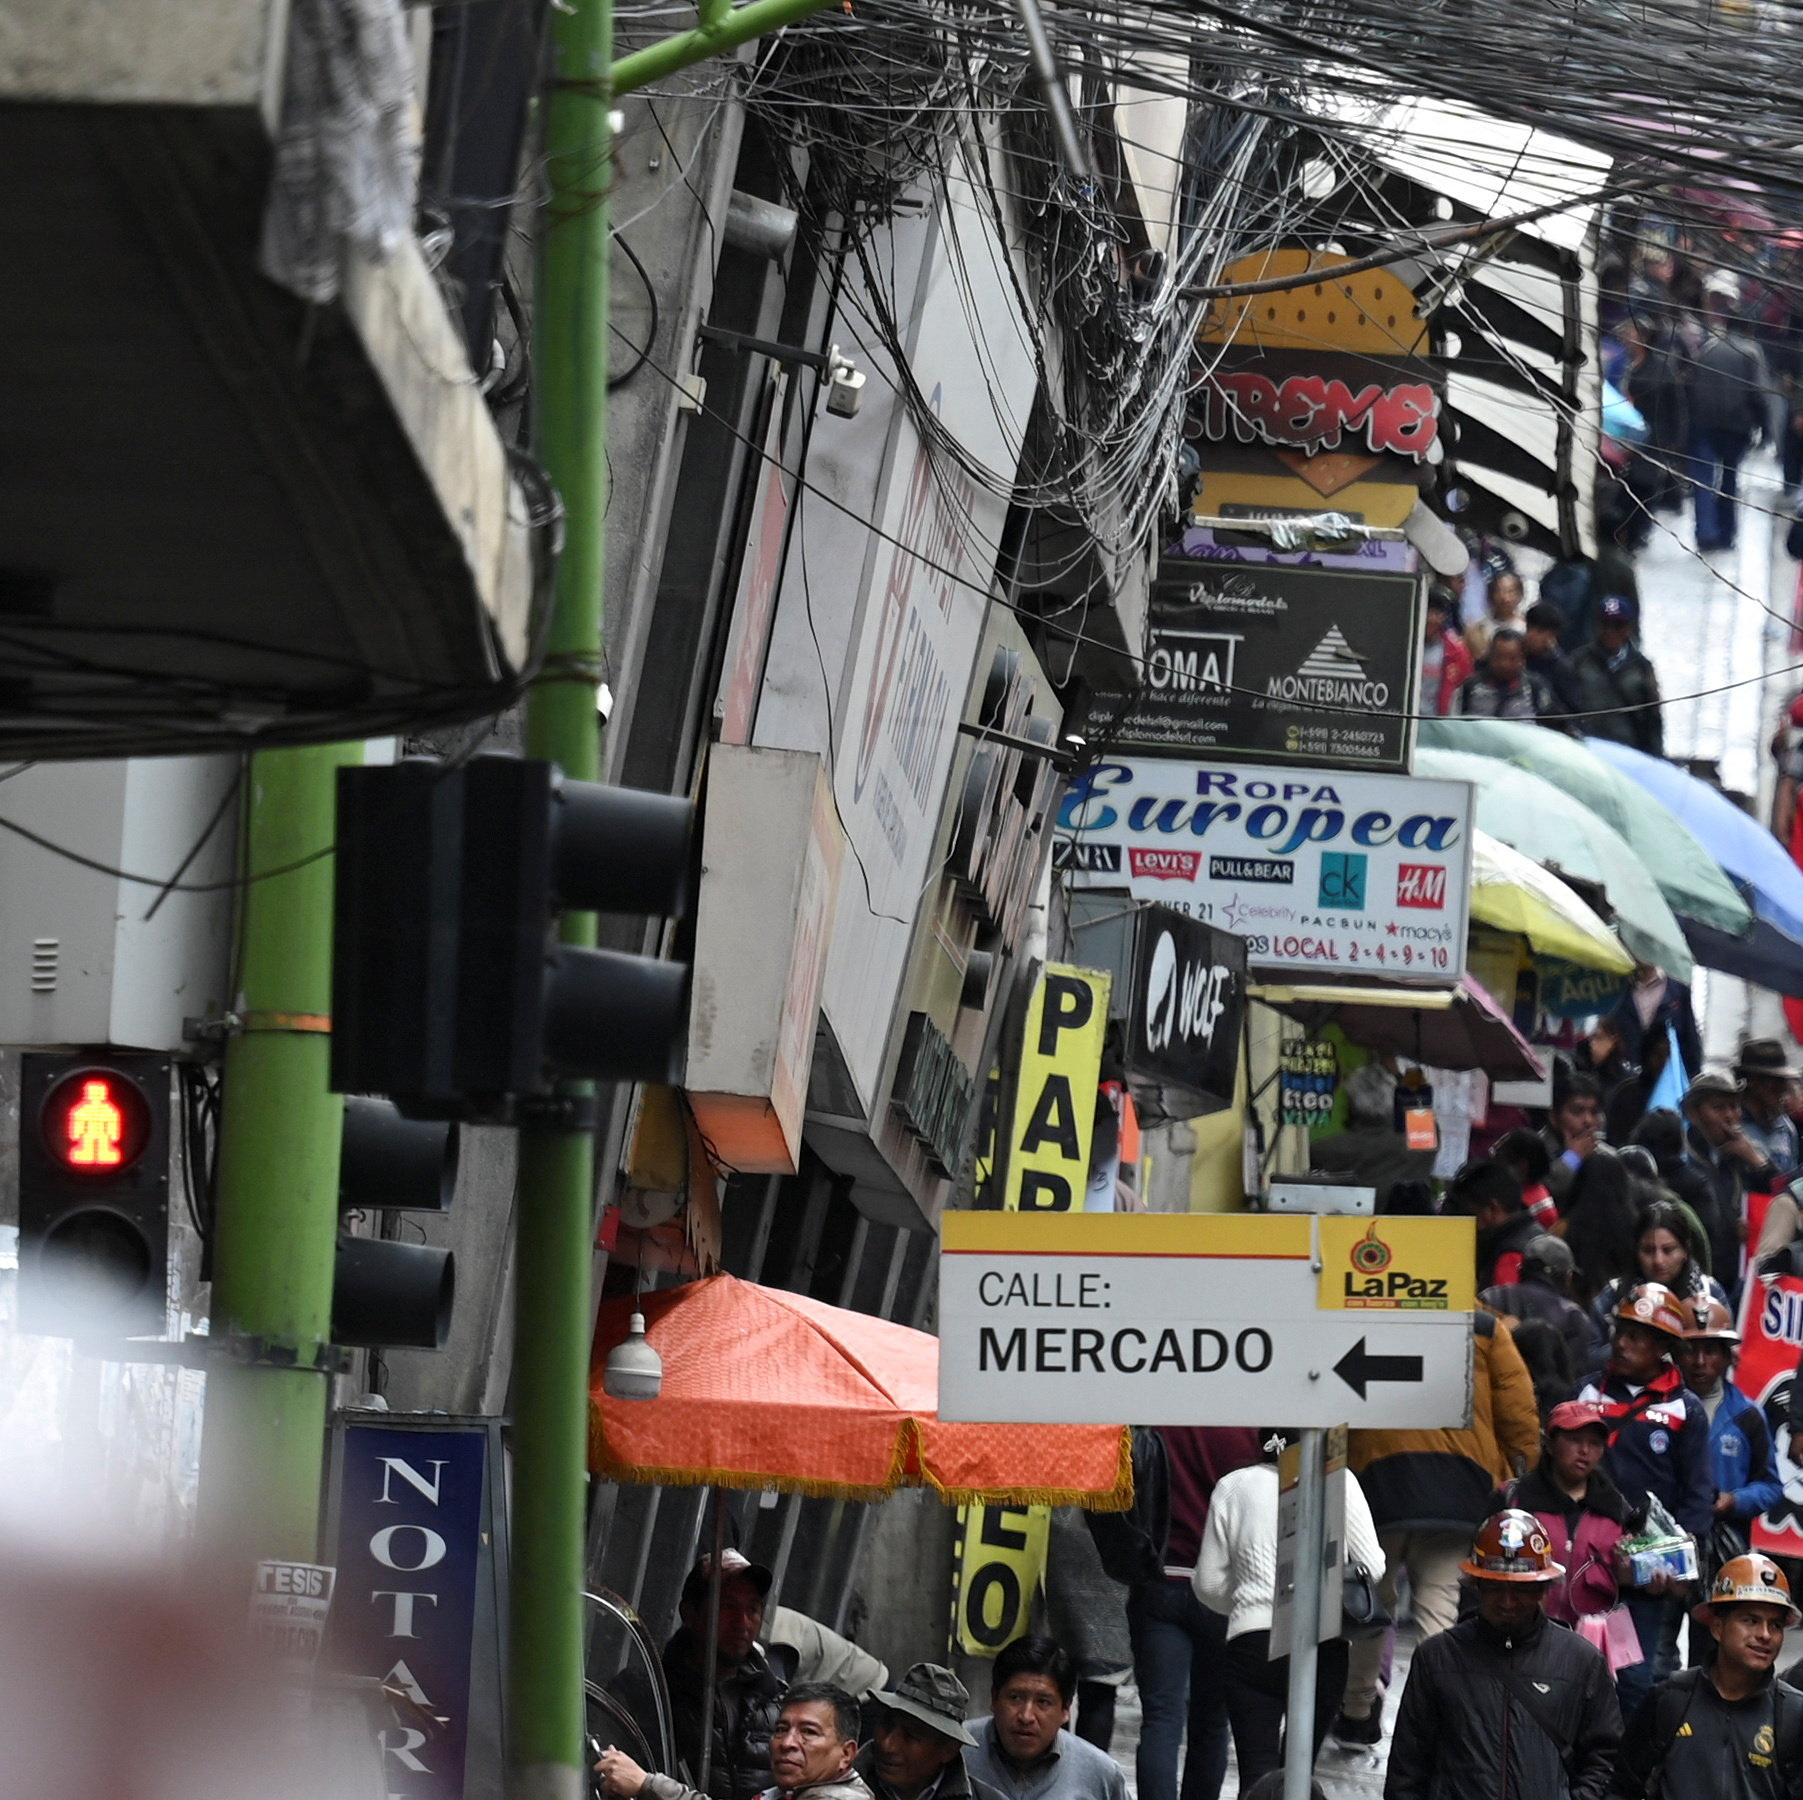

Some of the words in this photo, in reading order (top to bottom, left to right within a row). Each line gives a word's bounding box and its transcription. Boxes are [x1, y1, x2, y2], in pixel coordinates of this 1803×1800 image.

[1267, 675, 1389, 706] MONTEBIANCO
[1055, 764, 1460, 855] Europea
[1211, 860, 1291, 879] PULL&BEAR
[1273, 935, 1340, 961] LOCAL
[978, 1271, 1112, 1308] CALLE:
[978, 1327, 1273, 1374] MERCADO
